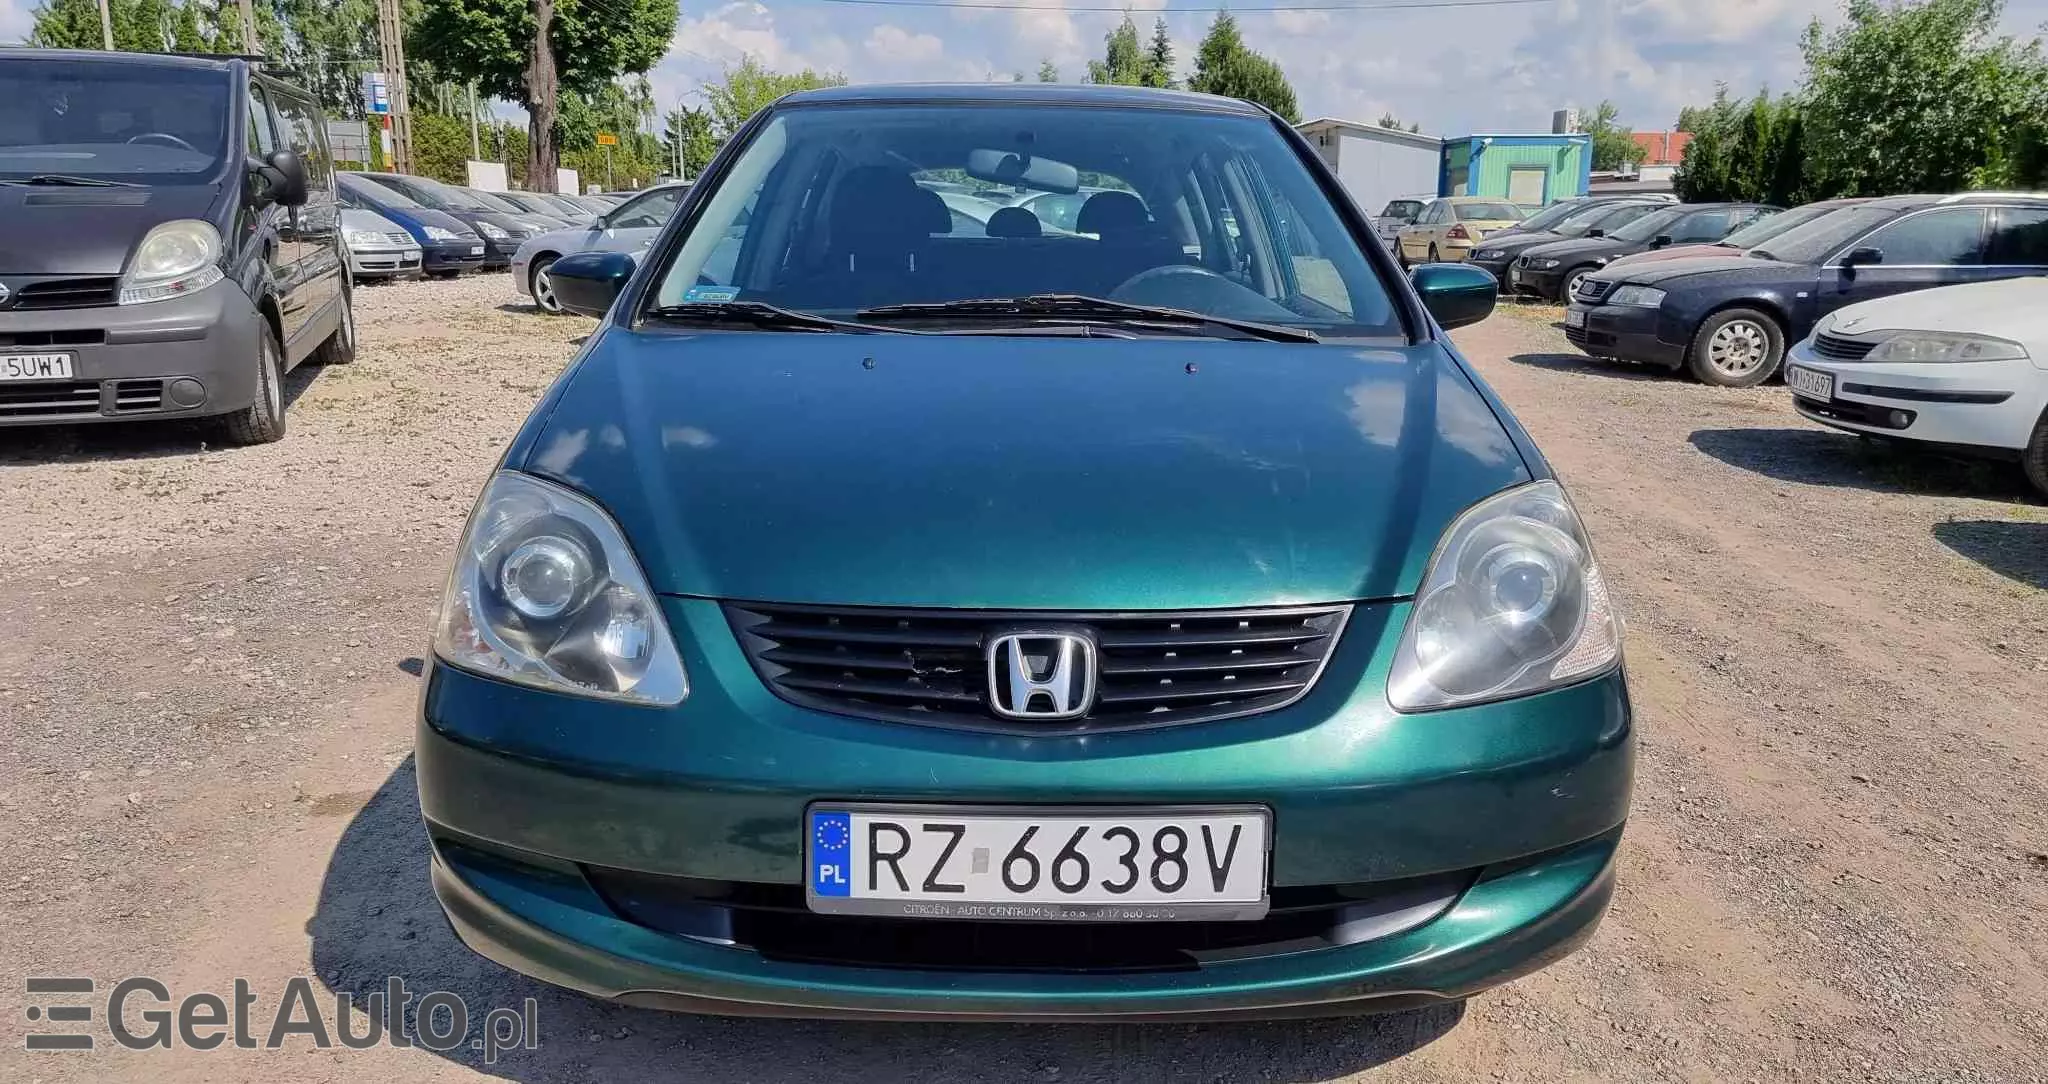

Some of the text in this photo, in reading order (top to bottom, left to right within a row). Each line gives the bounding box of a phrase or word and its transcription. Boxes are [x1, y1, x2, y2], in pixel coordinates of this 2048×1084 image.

[7, 357, 65, 377] 5UW1
[819, 822, 1242, 894] PL RZ 6638V
[957, 905, 987, 916] AUTO
[989, 906, 1041, 917] CENTRUM
